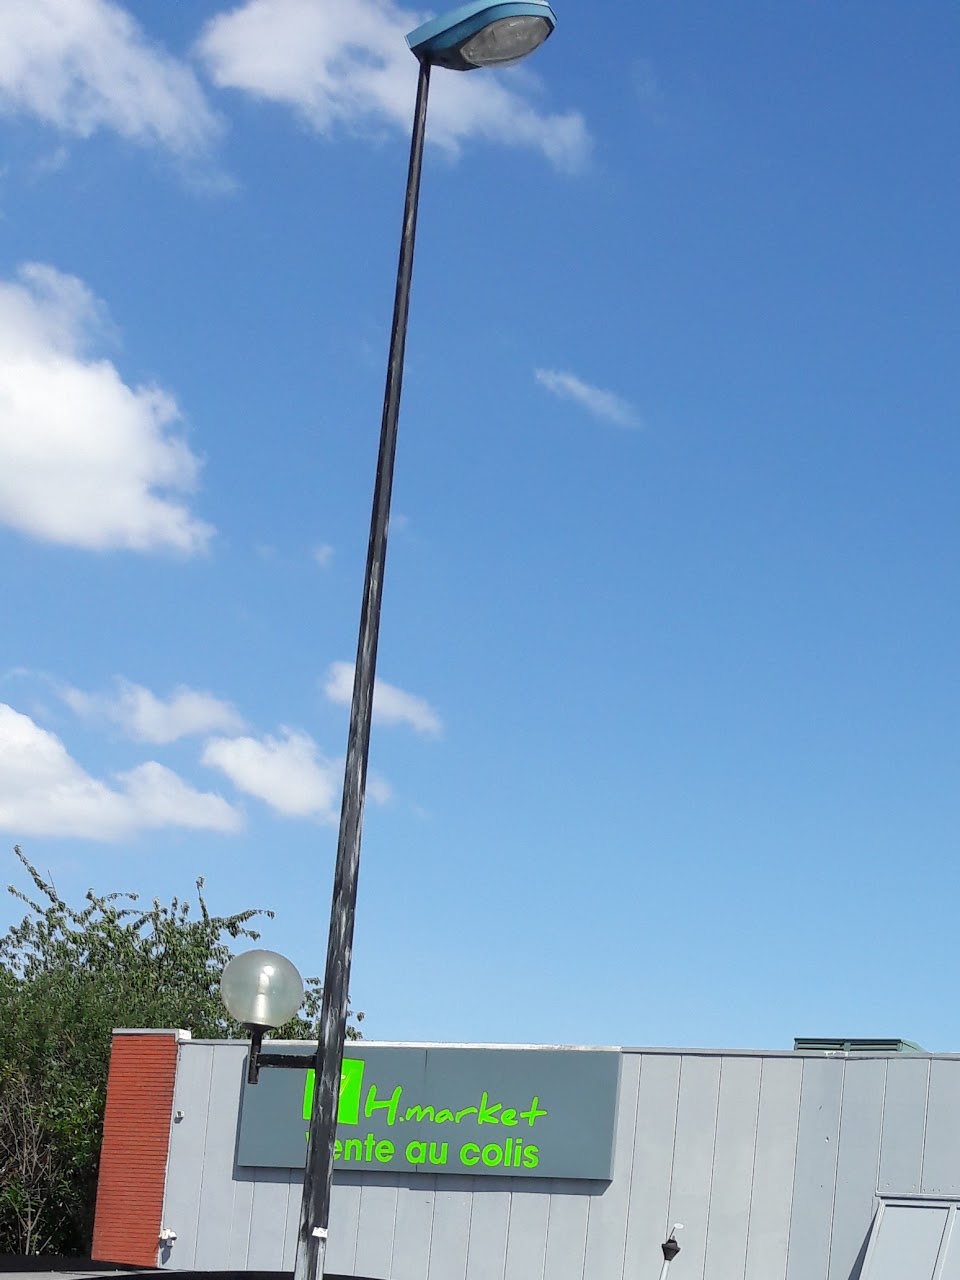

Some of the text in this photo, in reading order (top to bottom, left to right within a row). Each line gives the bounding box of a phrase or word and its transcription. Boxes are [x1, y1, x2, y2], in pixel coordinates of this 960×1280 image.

[364, 1084, 548, 1127] H.market
[305, 1131, 540, 1168] ente au colis
